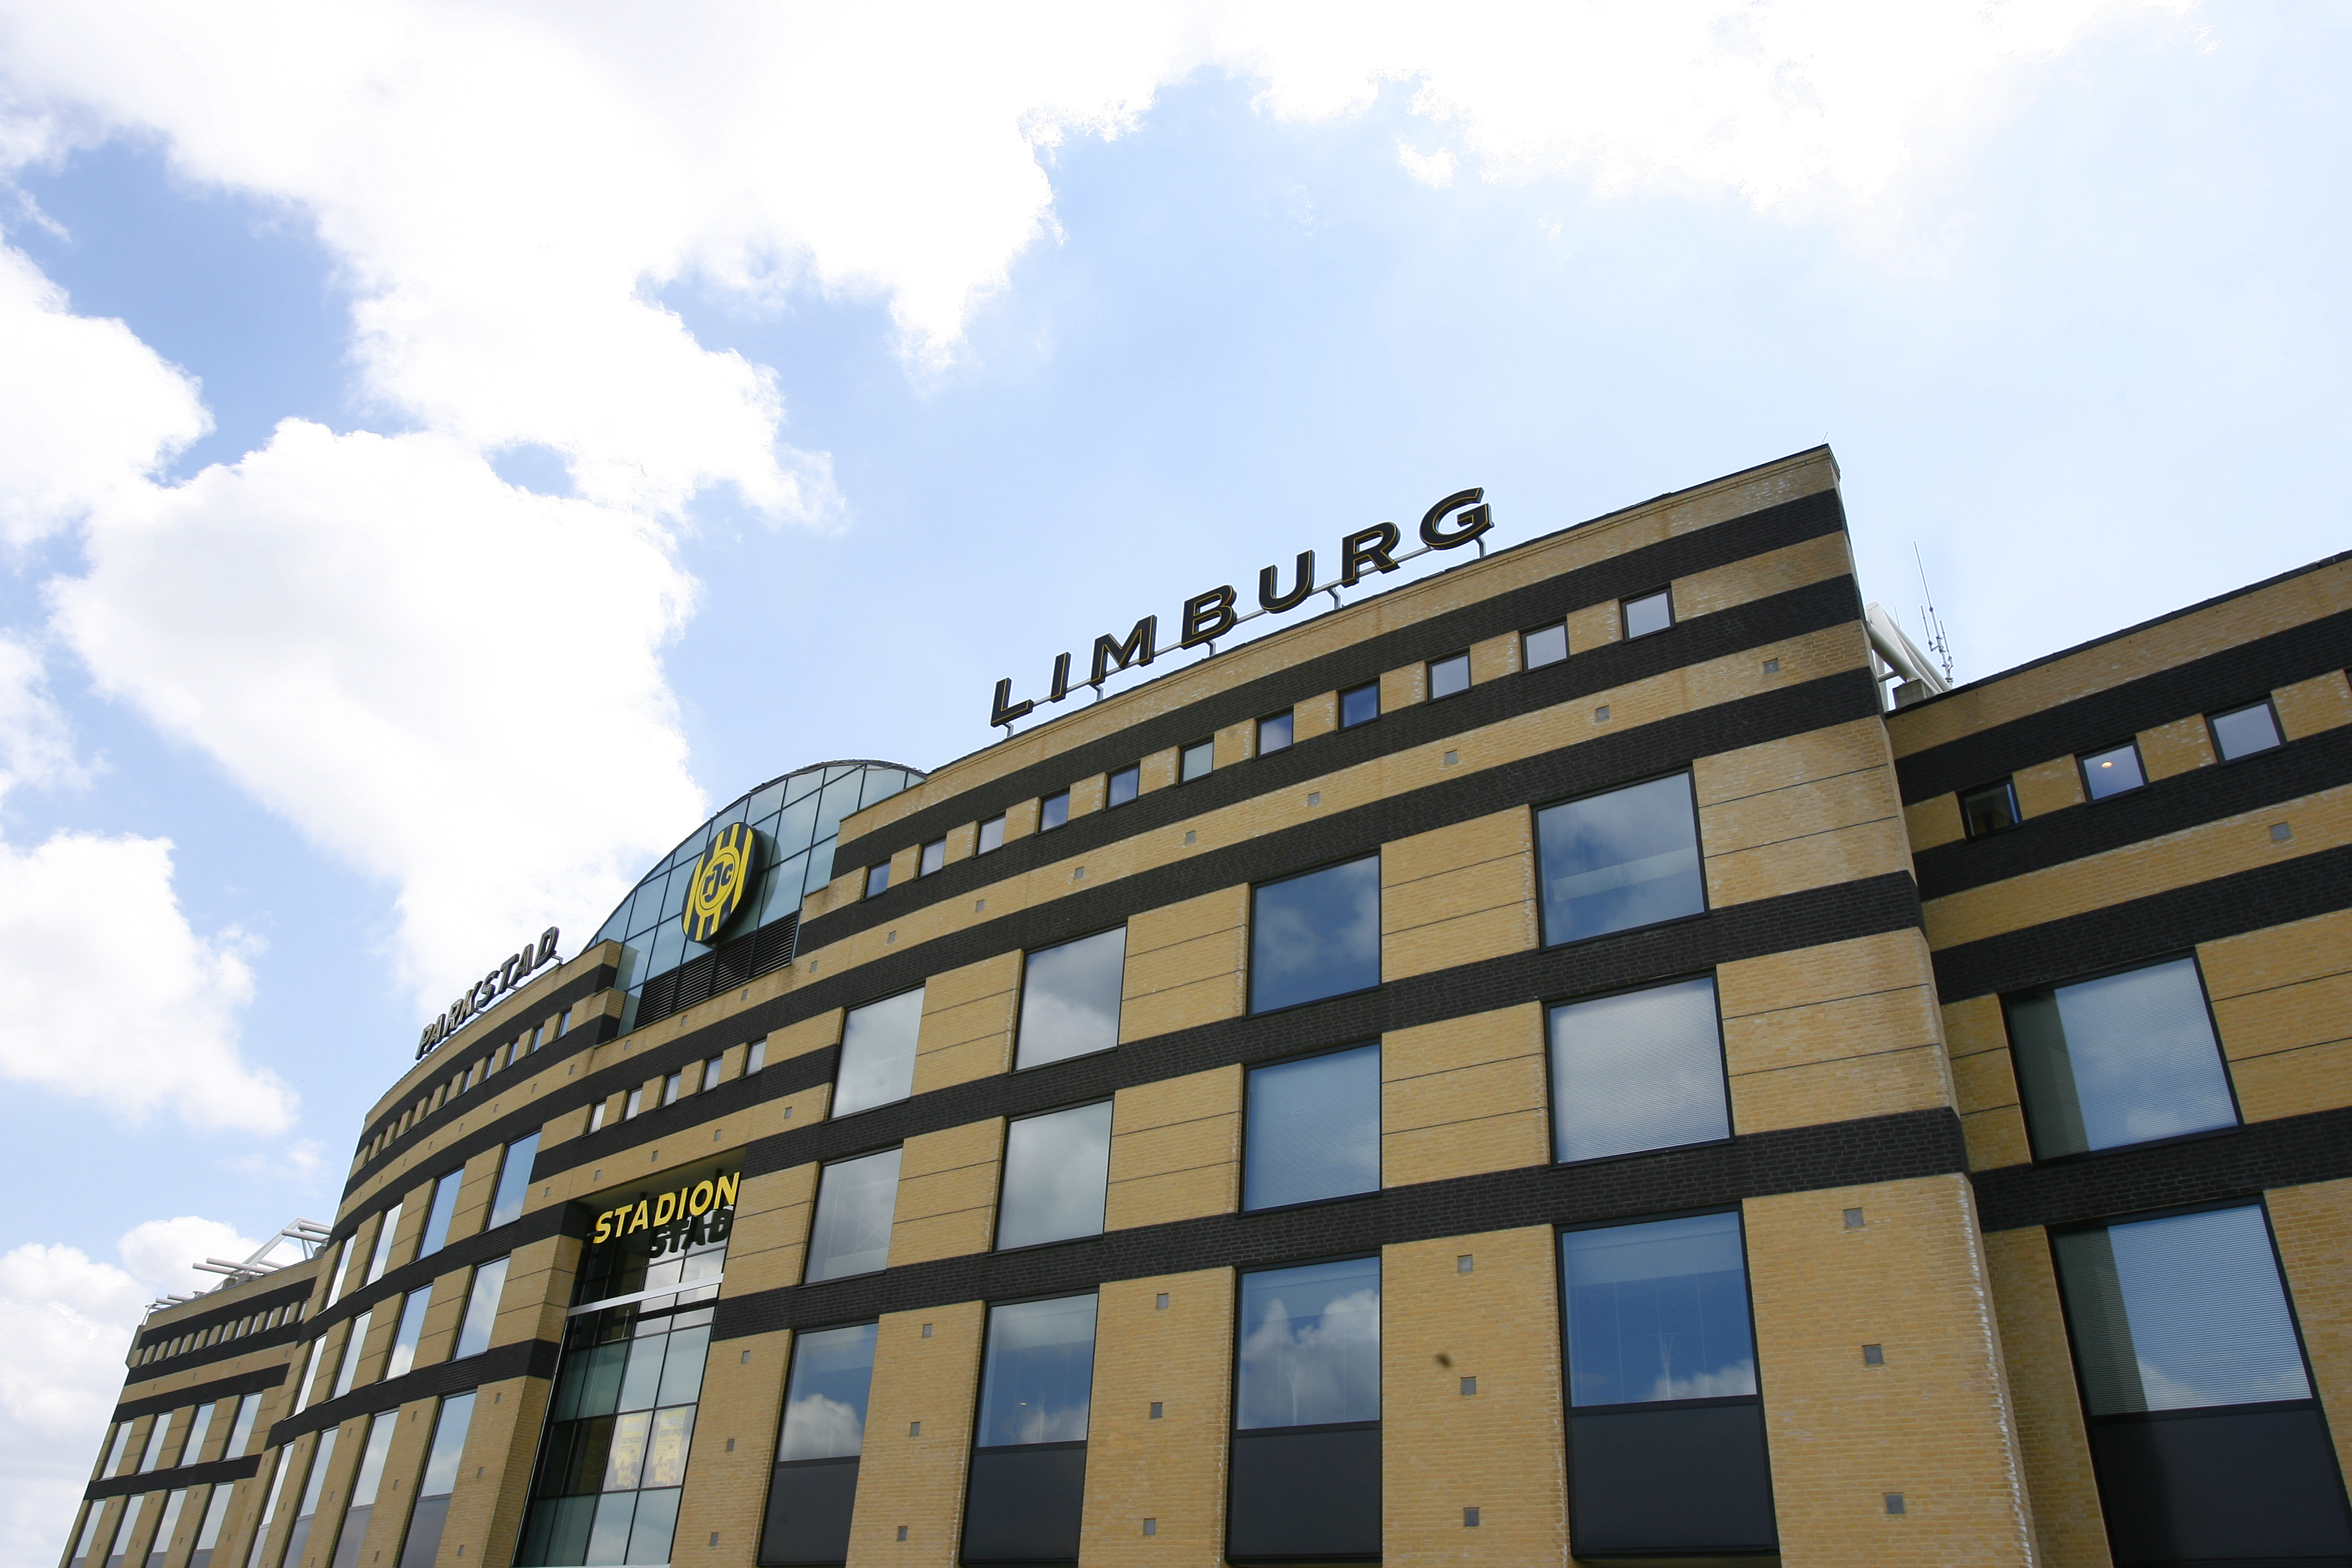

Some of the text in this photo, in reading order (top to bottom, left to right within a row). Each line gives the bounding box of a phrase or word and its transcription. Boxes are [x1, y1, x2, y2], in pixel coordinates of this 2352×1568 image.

[990, 487, 1495, 728] LIMBURG
[414, 926, 560, 1061] PARKSTAD
[593, 1171, 740, 1244] STADION
